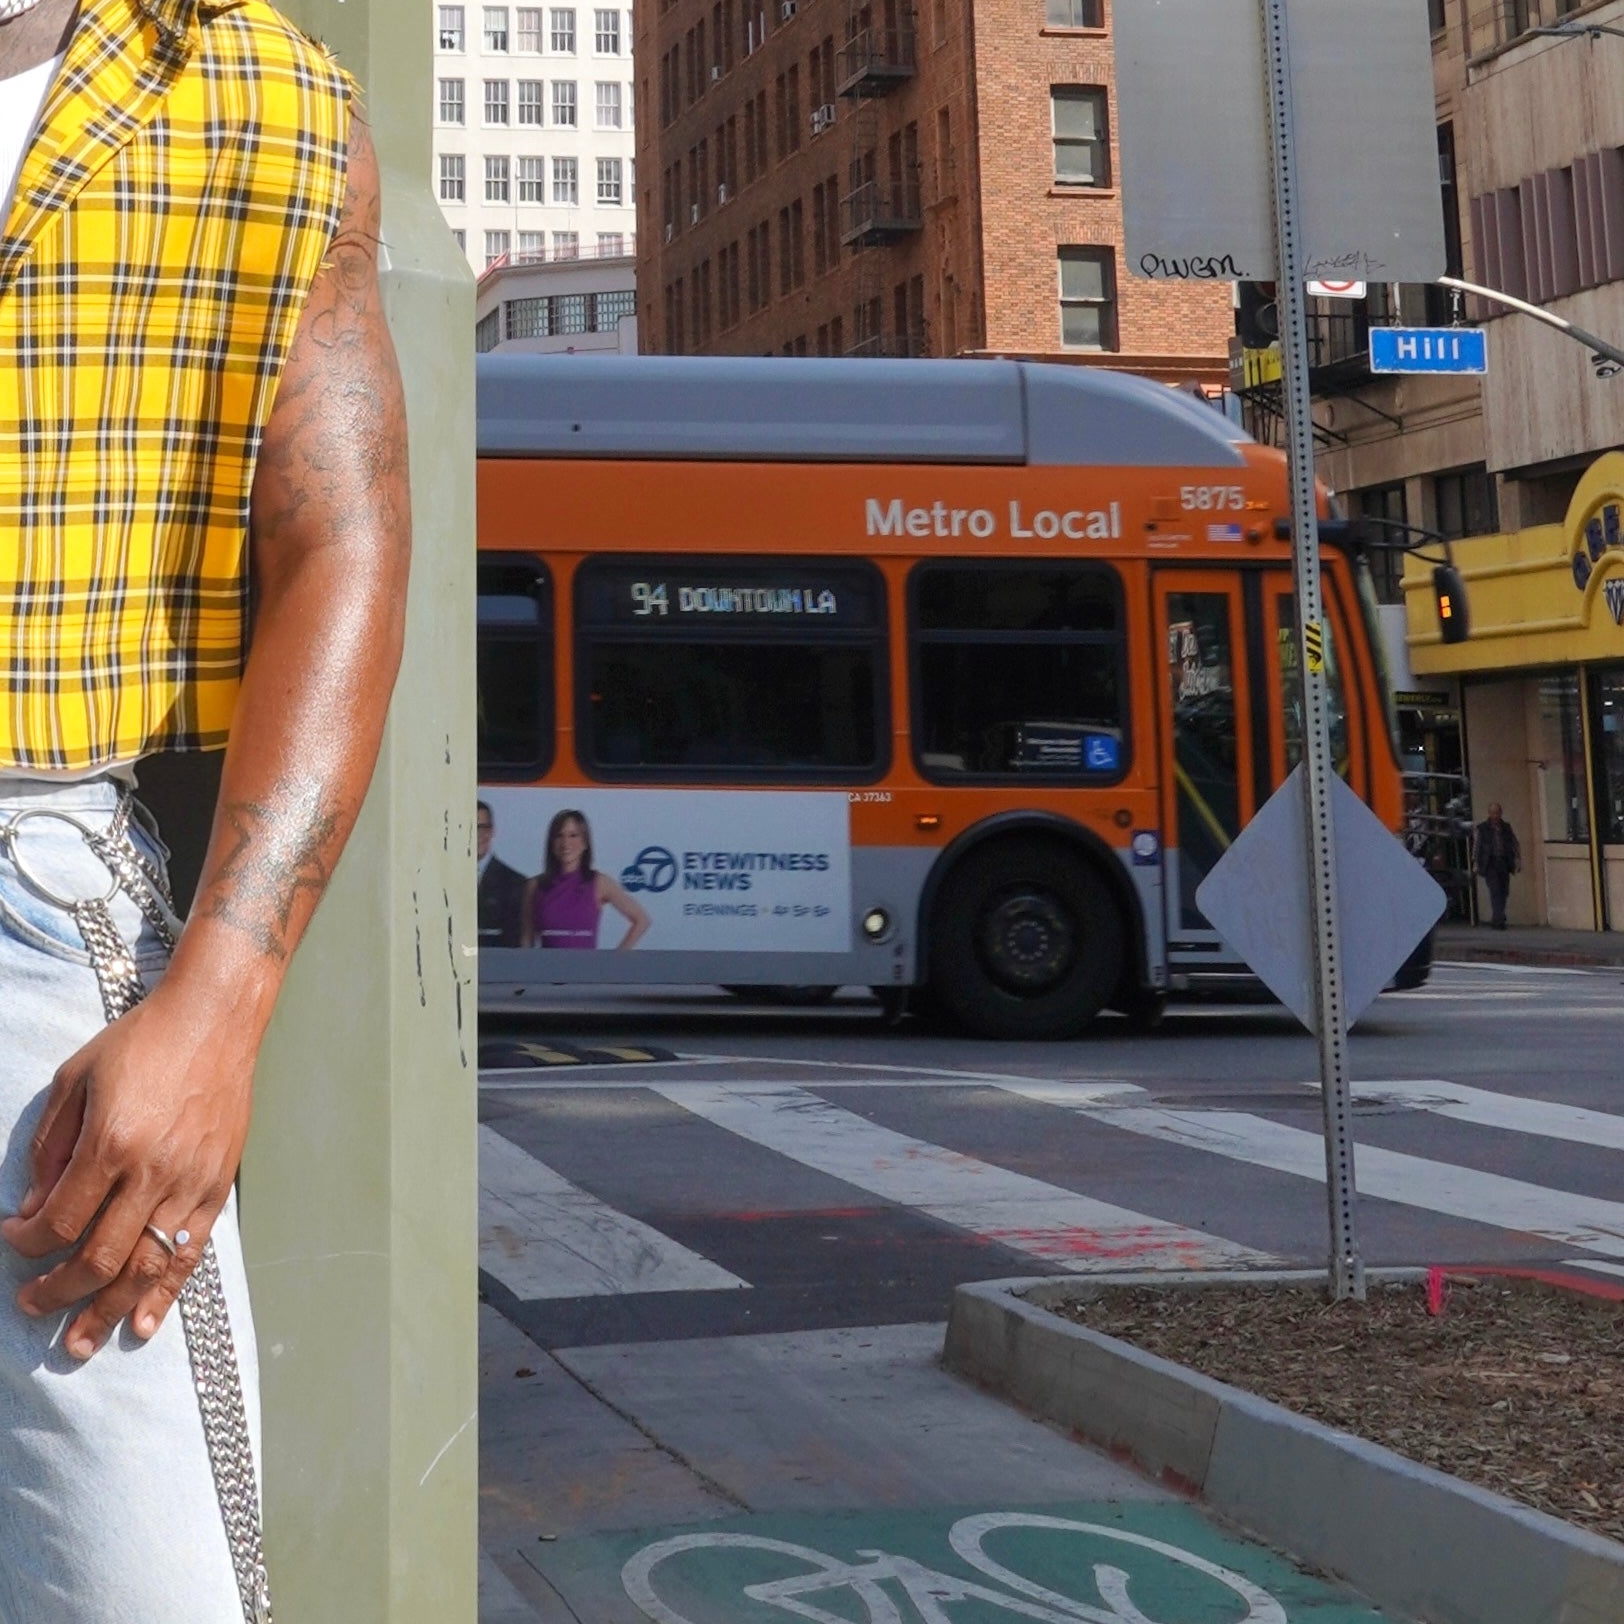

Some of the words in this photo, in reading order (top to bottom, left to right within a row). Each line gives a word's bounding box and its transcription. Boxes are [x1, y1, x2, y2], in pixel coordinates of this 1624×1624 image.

[1397, 337, 1460, 360] Hill
[1179, 485, 1245, 510] 5875
[864, 498, 995, 537] Metro
[1009, 500, 1122, 539] Local
[630, 582, 670, 615] 94
[682, 851, 830, 872] EYEWITNESS
[682, 872, 753, 891] NEWS
